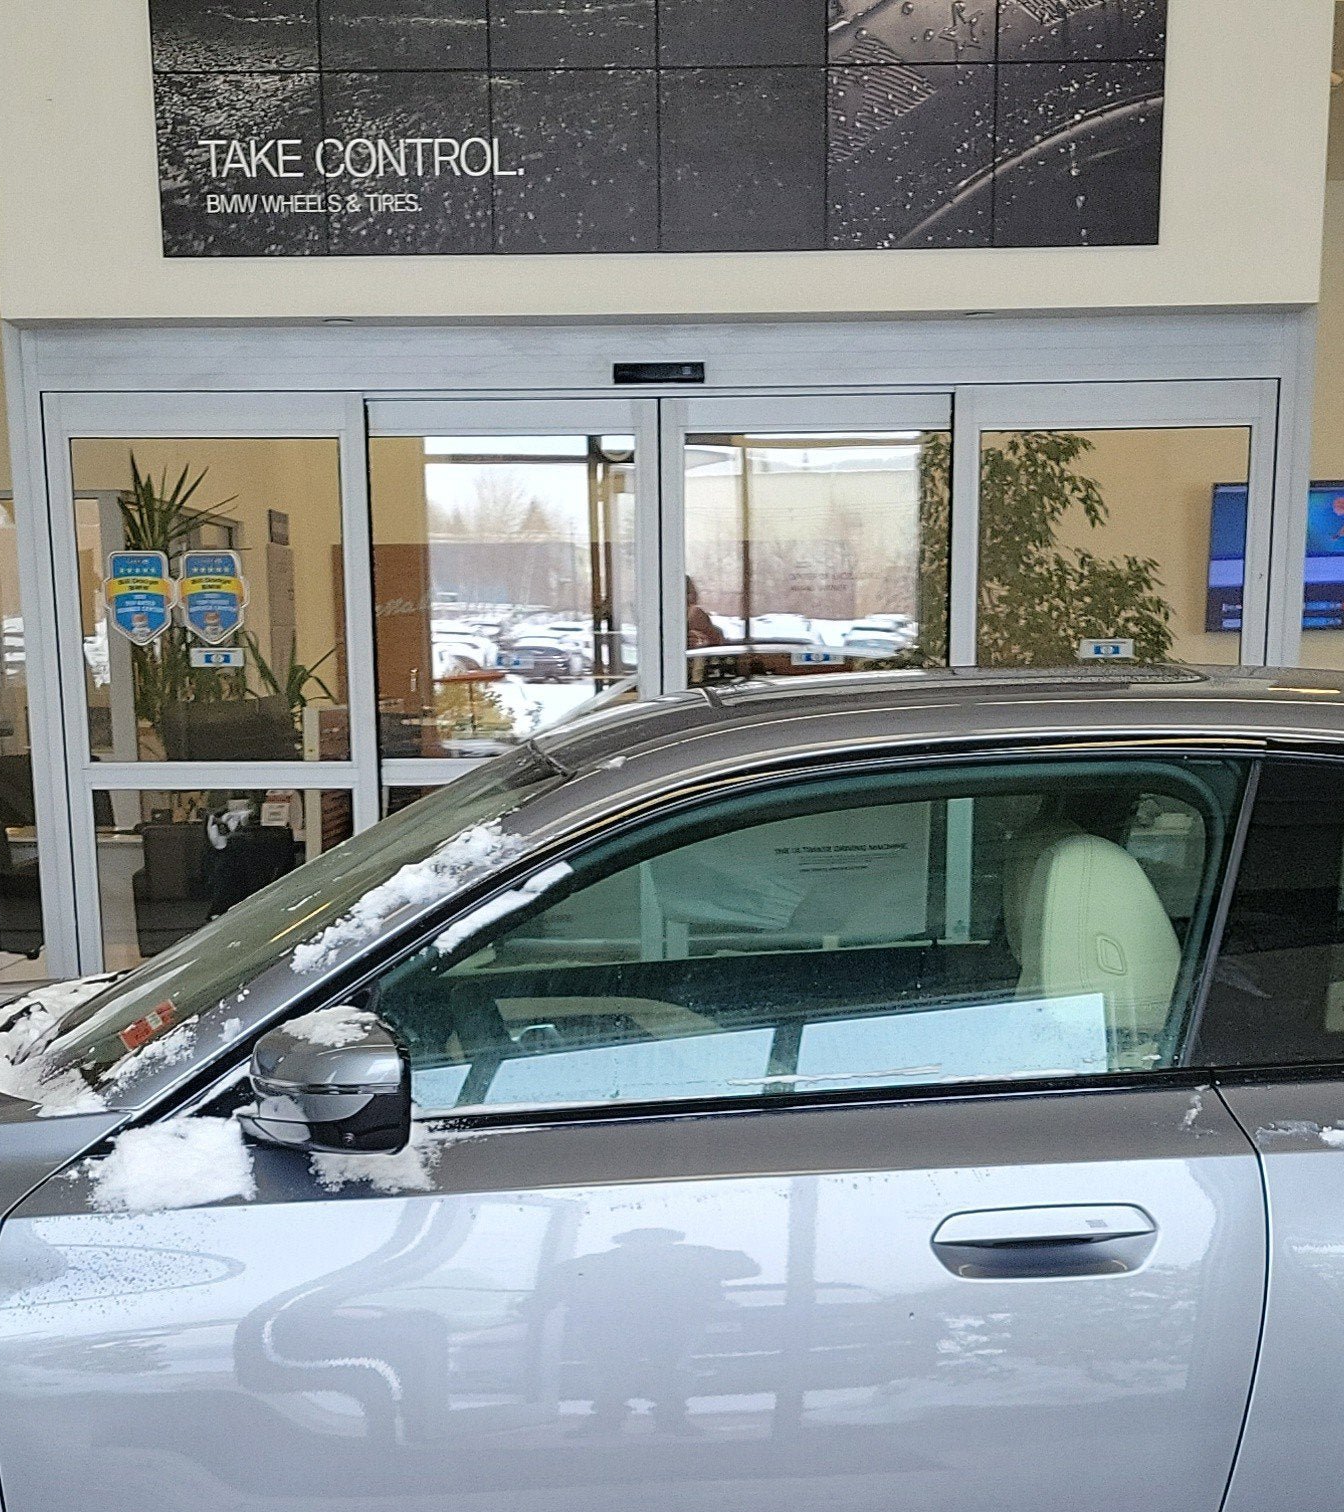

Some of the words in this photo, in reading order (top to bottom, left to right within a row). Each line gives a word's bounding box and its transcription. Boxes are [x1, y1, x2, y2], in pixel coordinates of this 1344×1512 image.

[197, 138, 303, 178] TAKE
[314, 136, 525, 178] CONTROL.
[206, 193, 257, 214] BMW
[261, 193, 342, 214] WHEELS
[345, 193, 362, 213] &
[365, 192, 422, 213] TIRES.
